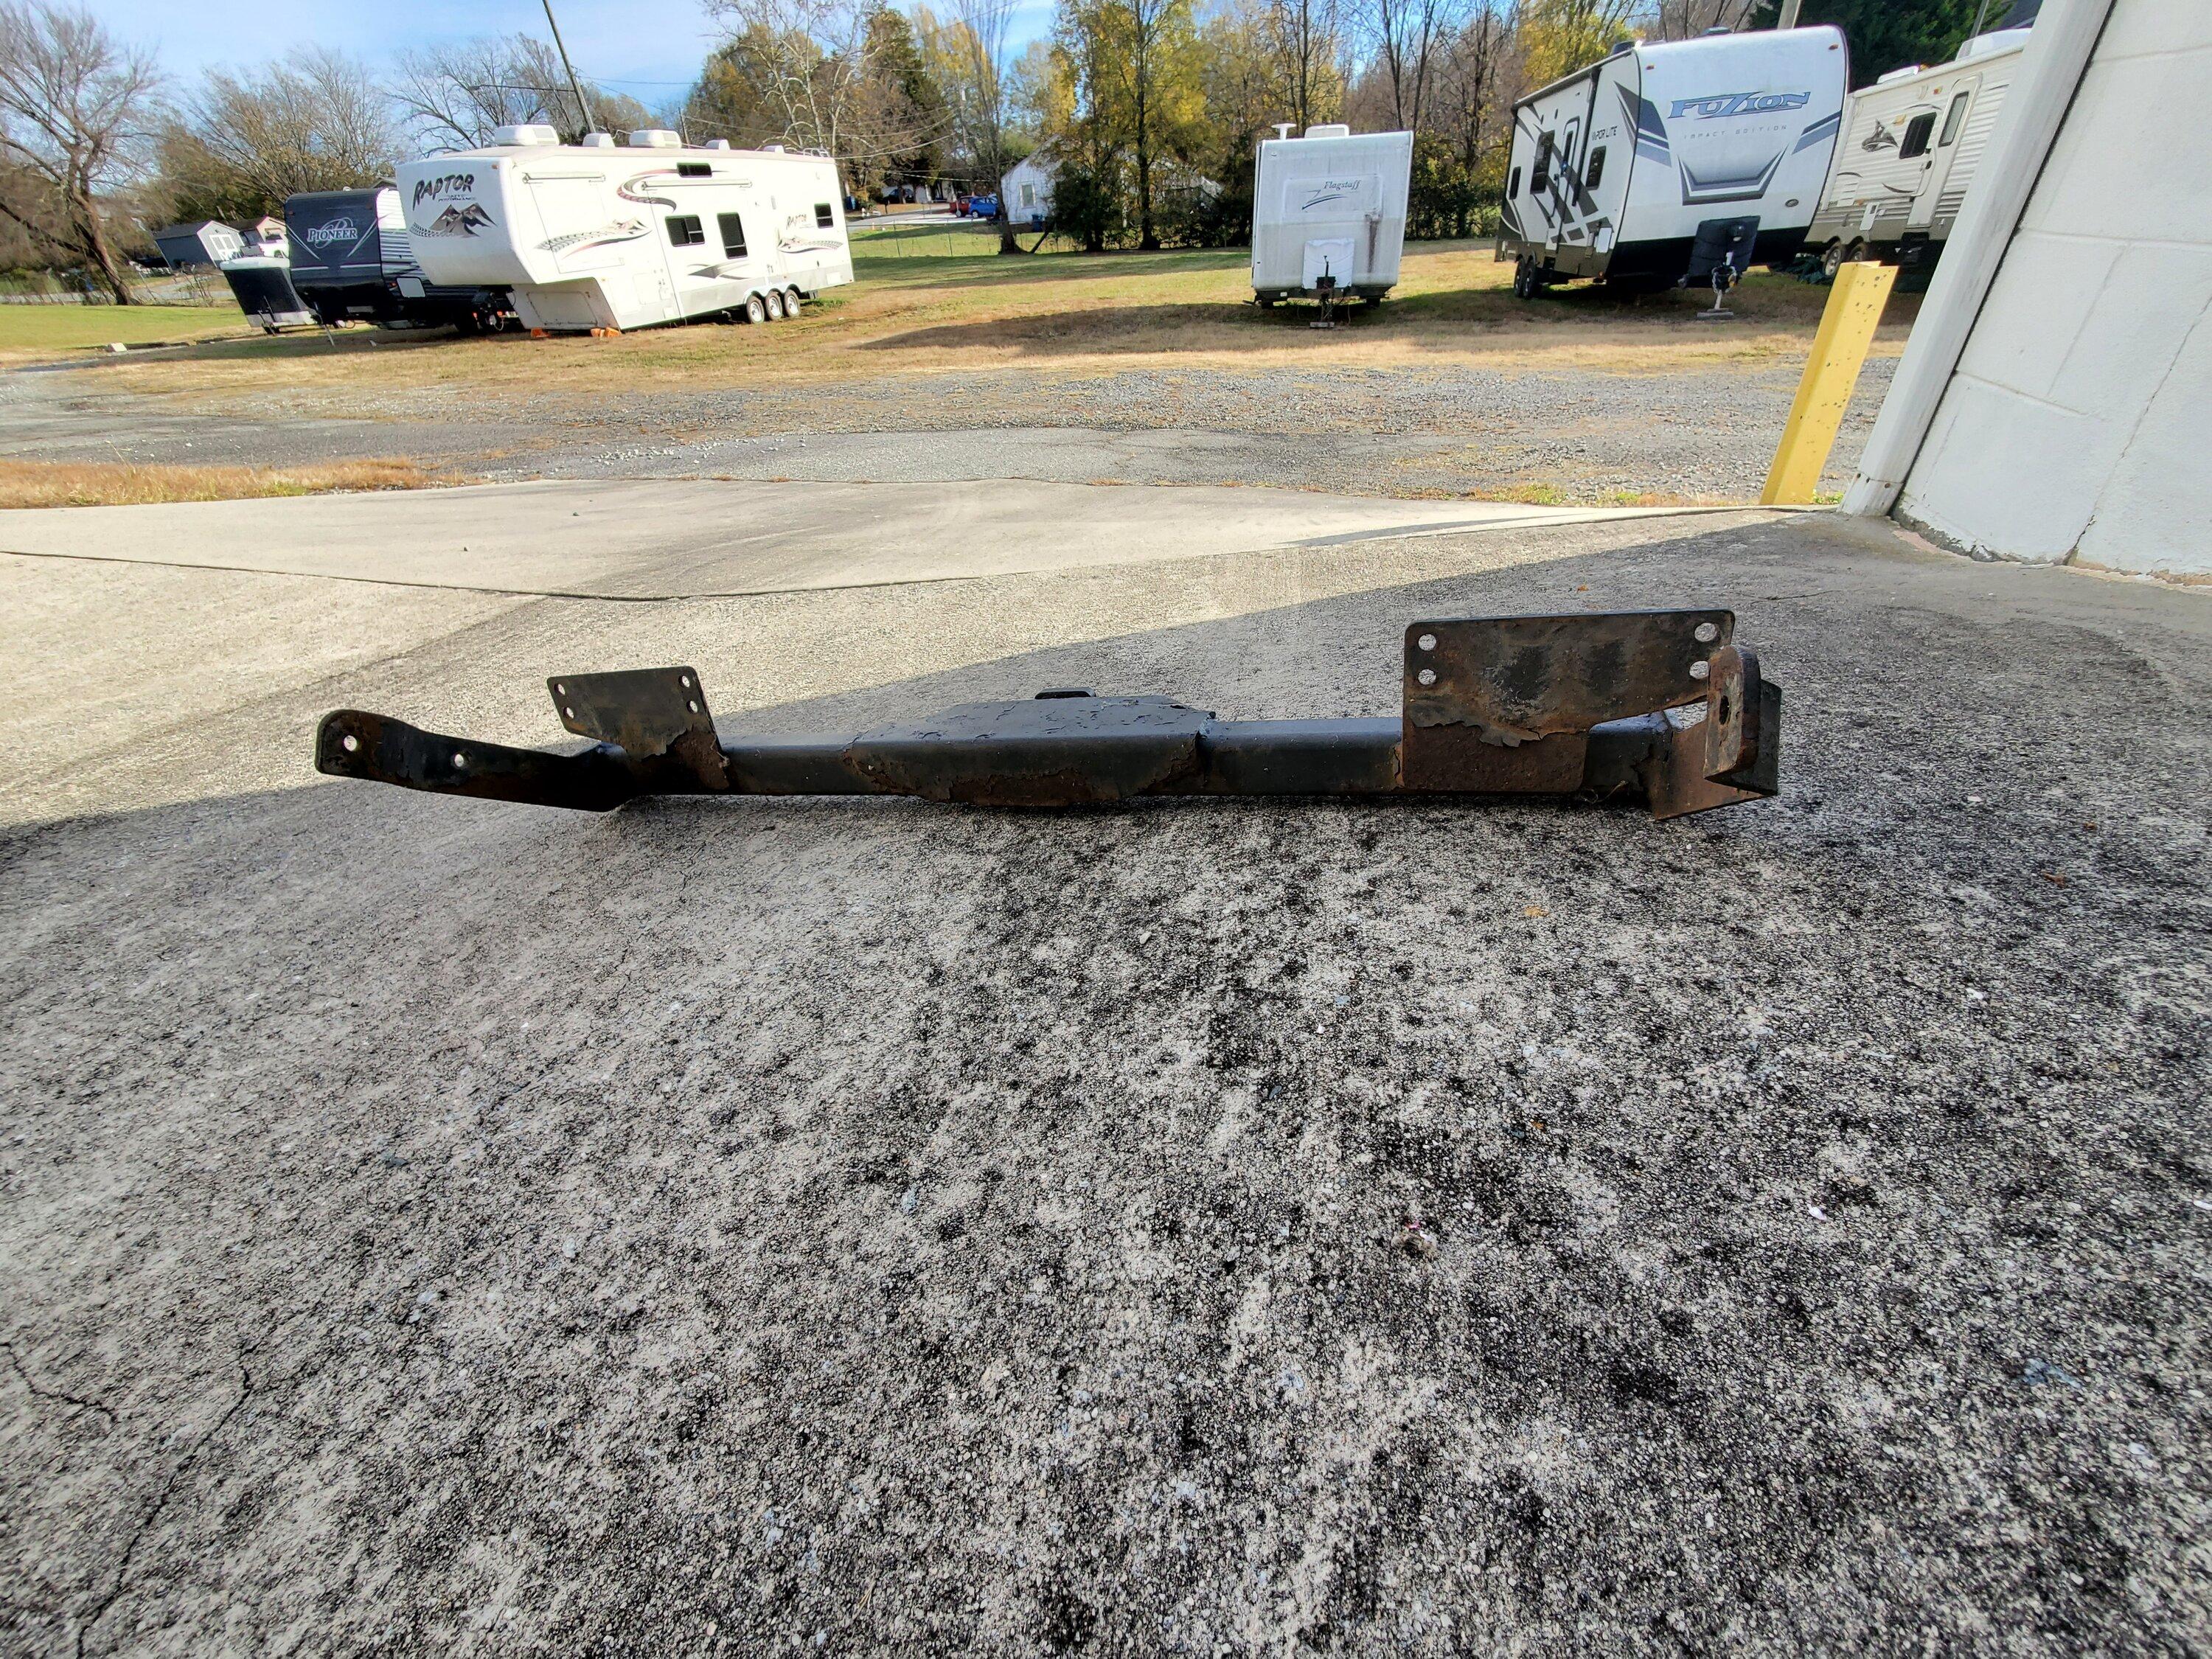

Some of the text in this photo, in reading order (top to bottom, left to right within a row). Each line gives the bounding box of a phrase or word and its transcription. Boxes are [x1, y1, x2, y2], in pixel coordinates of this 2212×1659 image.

[1735, 125, 1787, 134] EDITION
[413, 173, 474, 211] RAPTOR
[1324, 180, 1362, 191] Flagstaff
[307, 227, 358, 242] PIONEER
